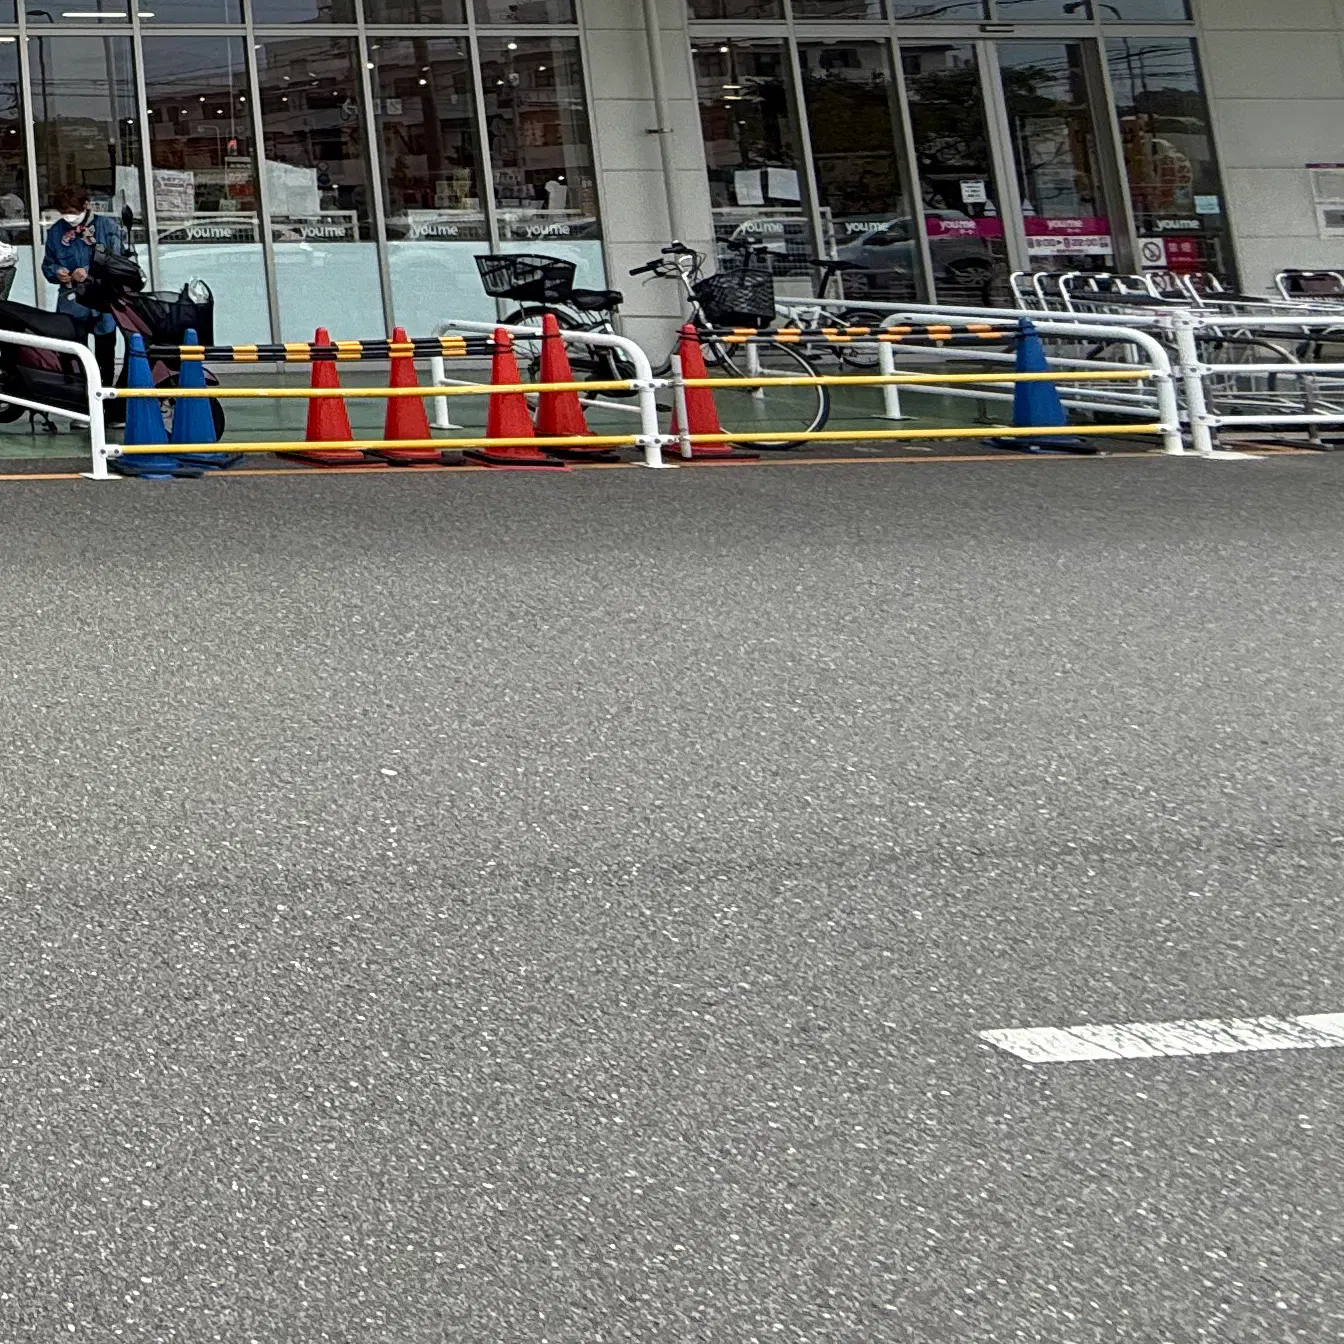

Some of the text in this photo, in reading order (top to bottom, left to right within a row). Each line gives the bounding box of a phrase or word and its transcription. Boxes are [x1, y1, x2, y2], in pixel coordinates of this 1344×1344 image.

[299, 225, 346, 238] youme
[413, 223, 459, 238] youme
[525, 223, 571, 237] youme
[740, 221, 784, 235] youme
[844, 220, 890, 234] youme
[1156, 219, 1201, 231] youme
[186, 227, 233, 240] youme
